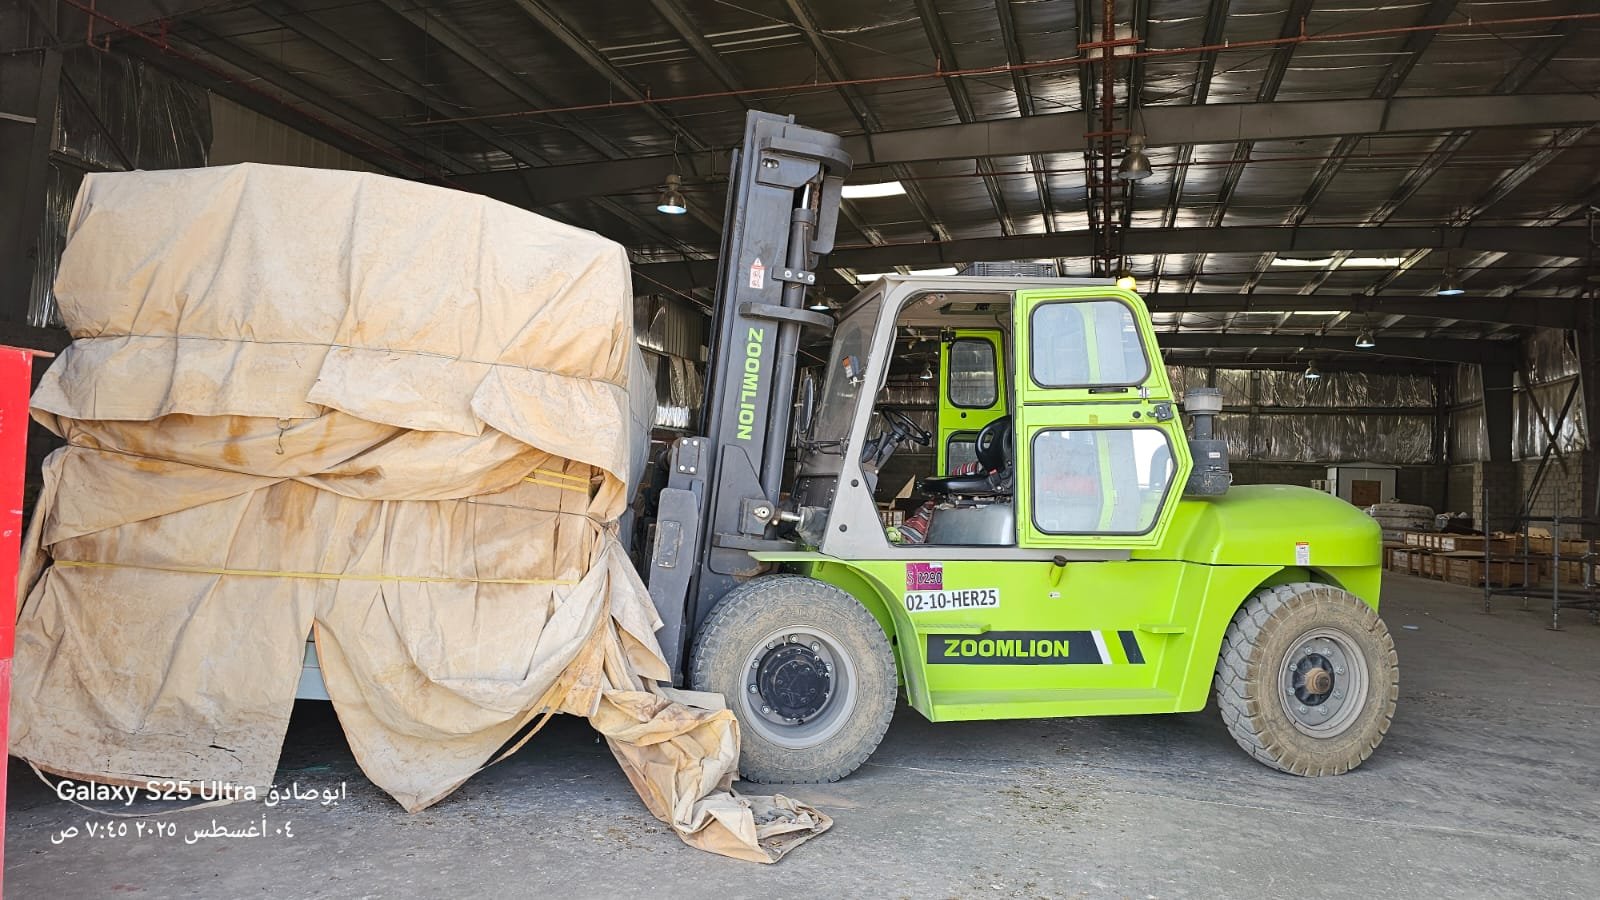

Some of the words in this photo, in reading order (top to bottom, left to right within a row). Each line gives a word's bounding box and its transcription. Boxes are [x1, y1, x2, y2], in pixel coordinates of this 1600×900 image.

[736, 328, 763, 440] ZOOMLION
[906, 590, 996, 611] 02-10-HER25
[944, 639, 1070, 657] ZOOMLION
